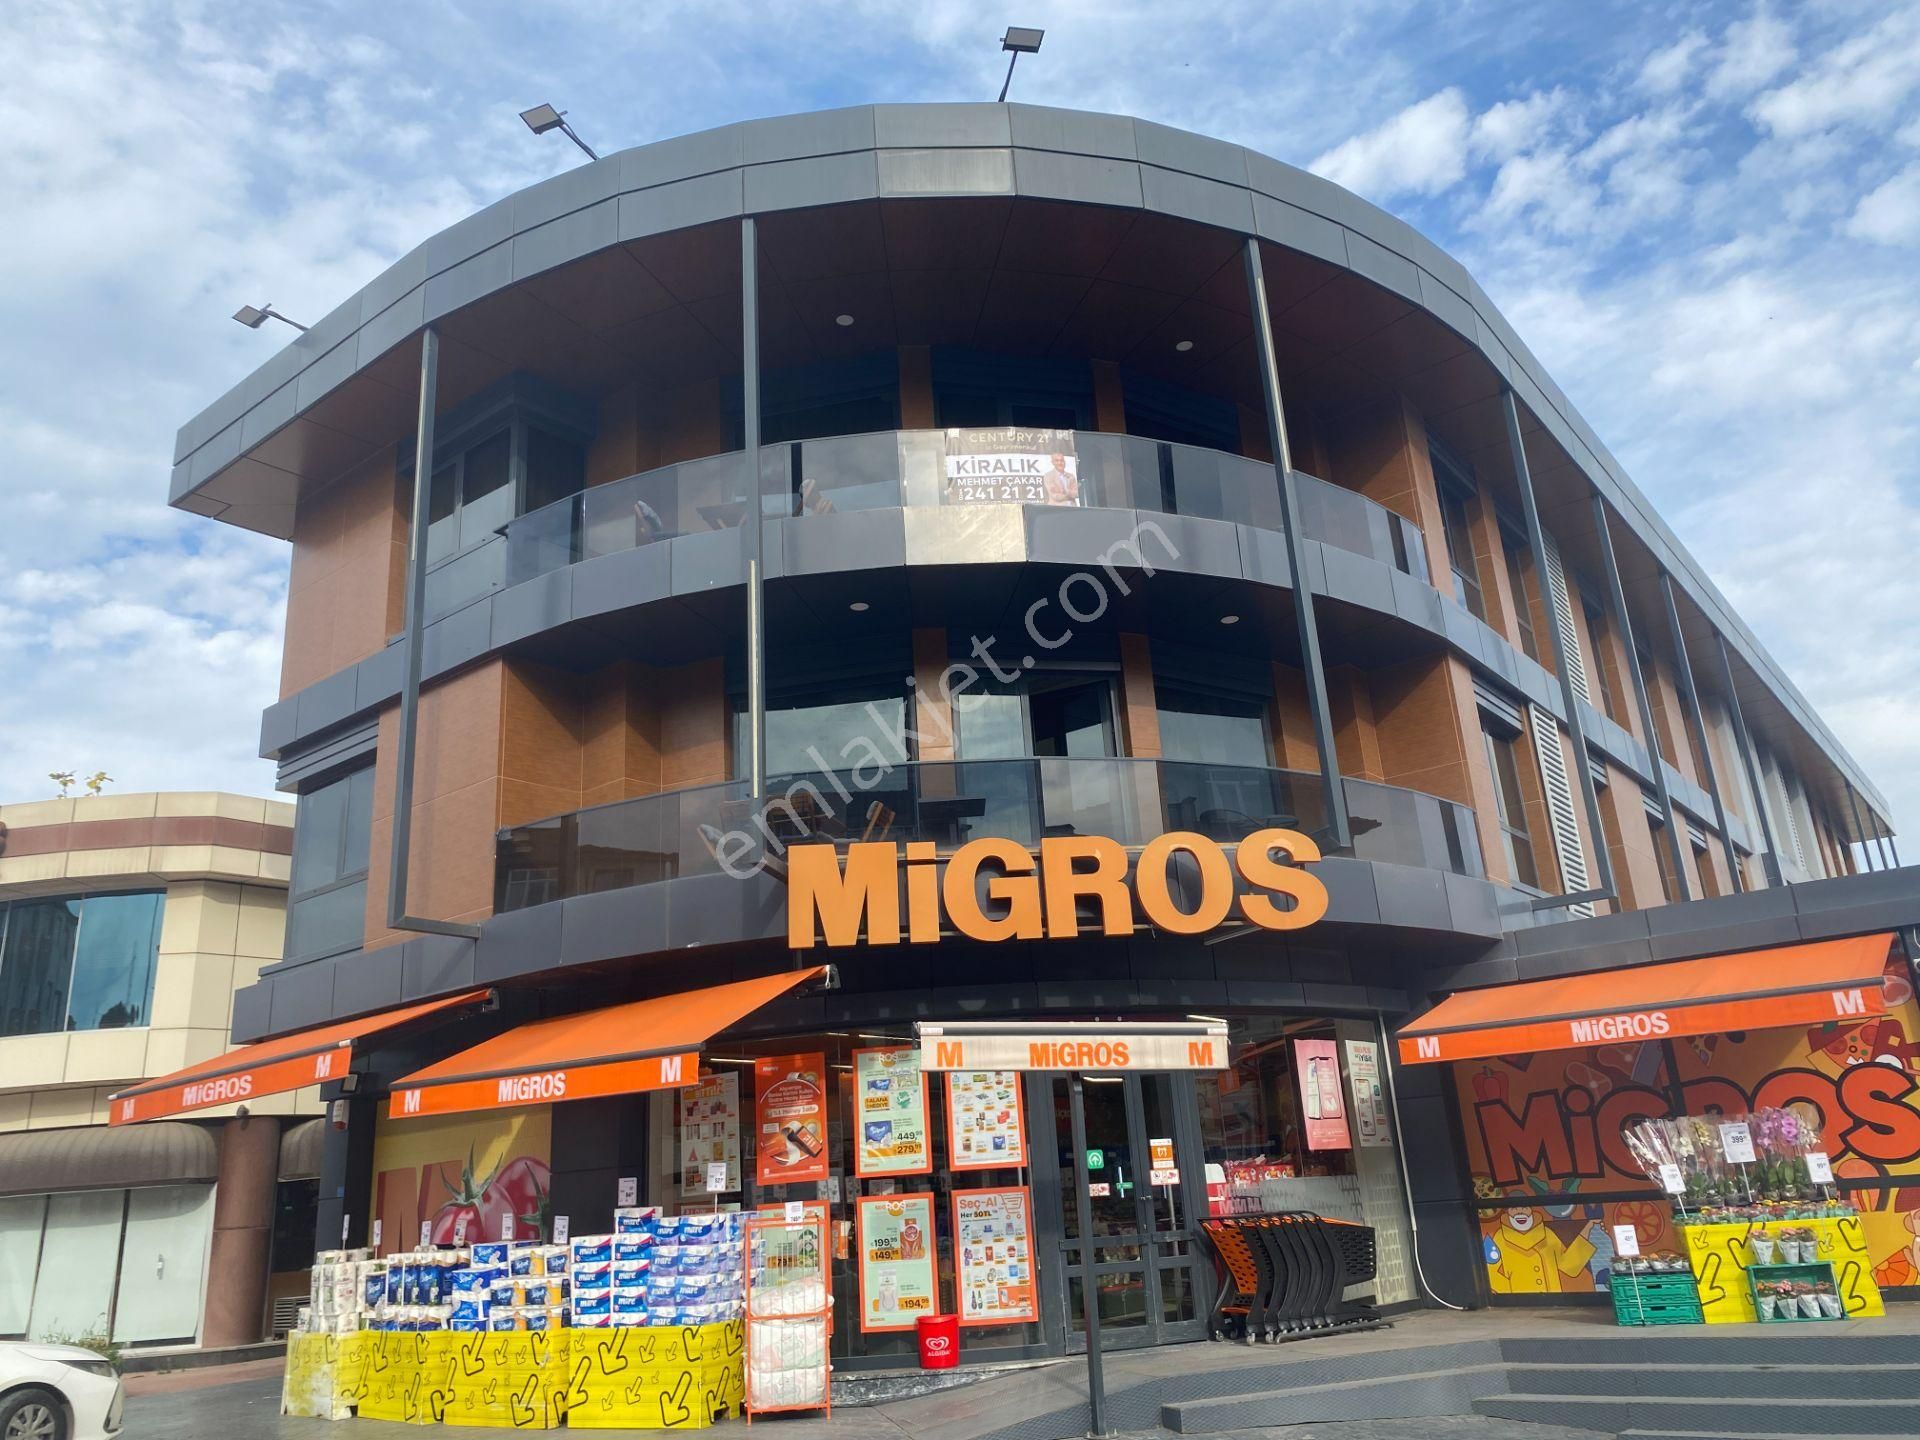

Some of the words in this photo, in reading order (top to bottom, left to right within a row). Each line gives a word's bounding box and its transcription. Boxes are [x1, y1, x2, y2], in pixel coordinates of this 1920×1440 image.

[969, 431, 1033, 442] CENTURY
[956, 456, 1040, 475] KİRALIK
[957, 477, 1003, 486] MEHMET
[1006, 476, 1043, 487] ÇAKAR
[964, 487, 995, 500] 241
[1001, 486, 1020, 499] 21
[1026, 486, 1045, 499] 21
[788, 828, 1329, 949] MiGROS
[1832, 989, 1866, 1016] M
[1571, 1012, 1670, 1043] MiGROS
[937, 1041, 963, 1067] M
[1029, 1042, 1129, 1067] MiGROS
[1188, 1042, 1213, 1066] M
[1418, 1036, 1440, 1059] M
[315, 1054, 331, 1079] M
[660, 1056, 681, 1083] M
[182, 1075, 252, 1107] MiGROS
[497, 1072, 567, 1103] MiGROS
[122, 1099, 135, 1121] M
[404, 1089, 421, 1113] M
